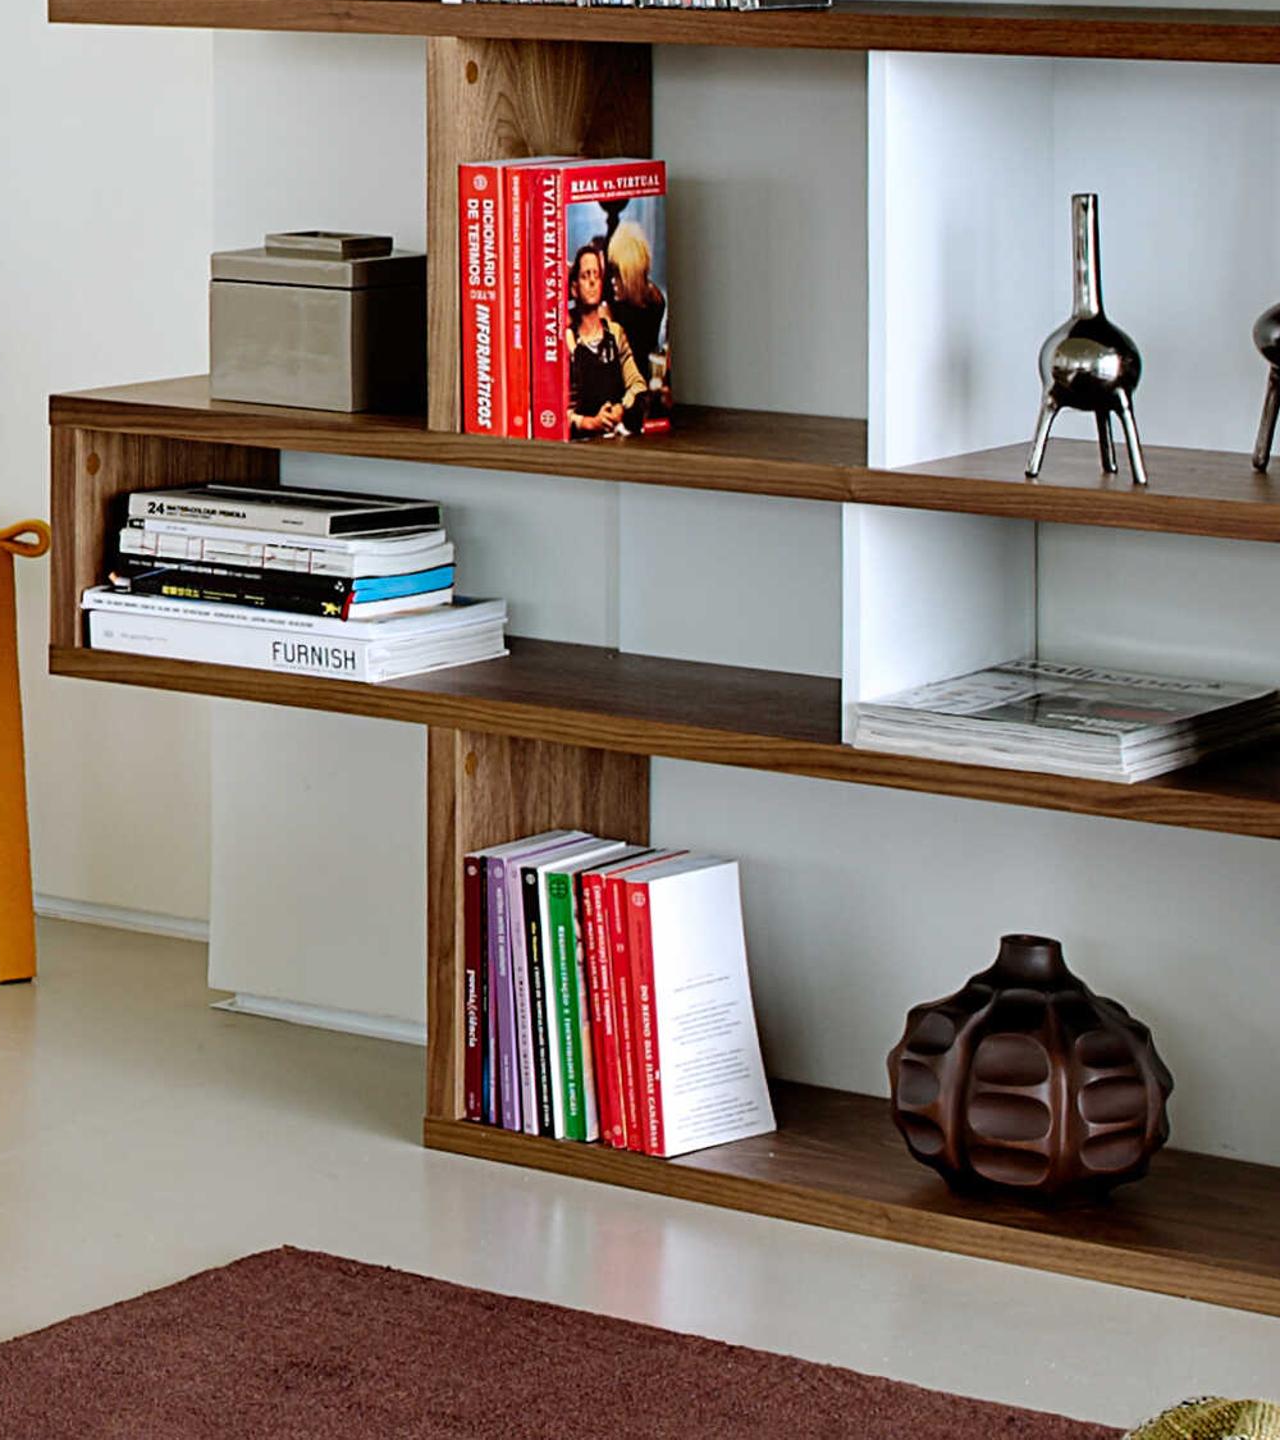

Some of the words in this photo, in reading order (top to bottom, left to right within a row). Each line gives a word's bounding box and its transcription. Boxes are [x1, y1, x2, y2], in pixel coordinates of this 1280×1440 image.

[467, 198, 480, 220] DE
[570, 178, 599, 193] REAL
[616, 174, 660, 189] VIRTUAL
[482, 198, 498, 287] DICIONÁRIO
[542, 173, 556, 269] VIRTUAL
[468, 222, 481, 286] TERMOS
[544, 307, 558, 363] REAL
[475, 303, 495, 429] INFORMÁTICOS
[147, 500, 164, 515] 24
[271, 640, 356, 670] FURNISH
